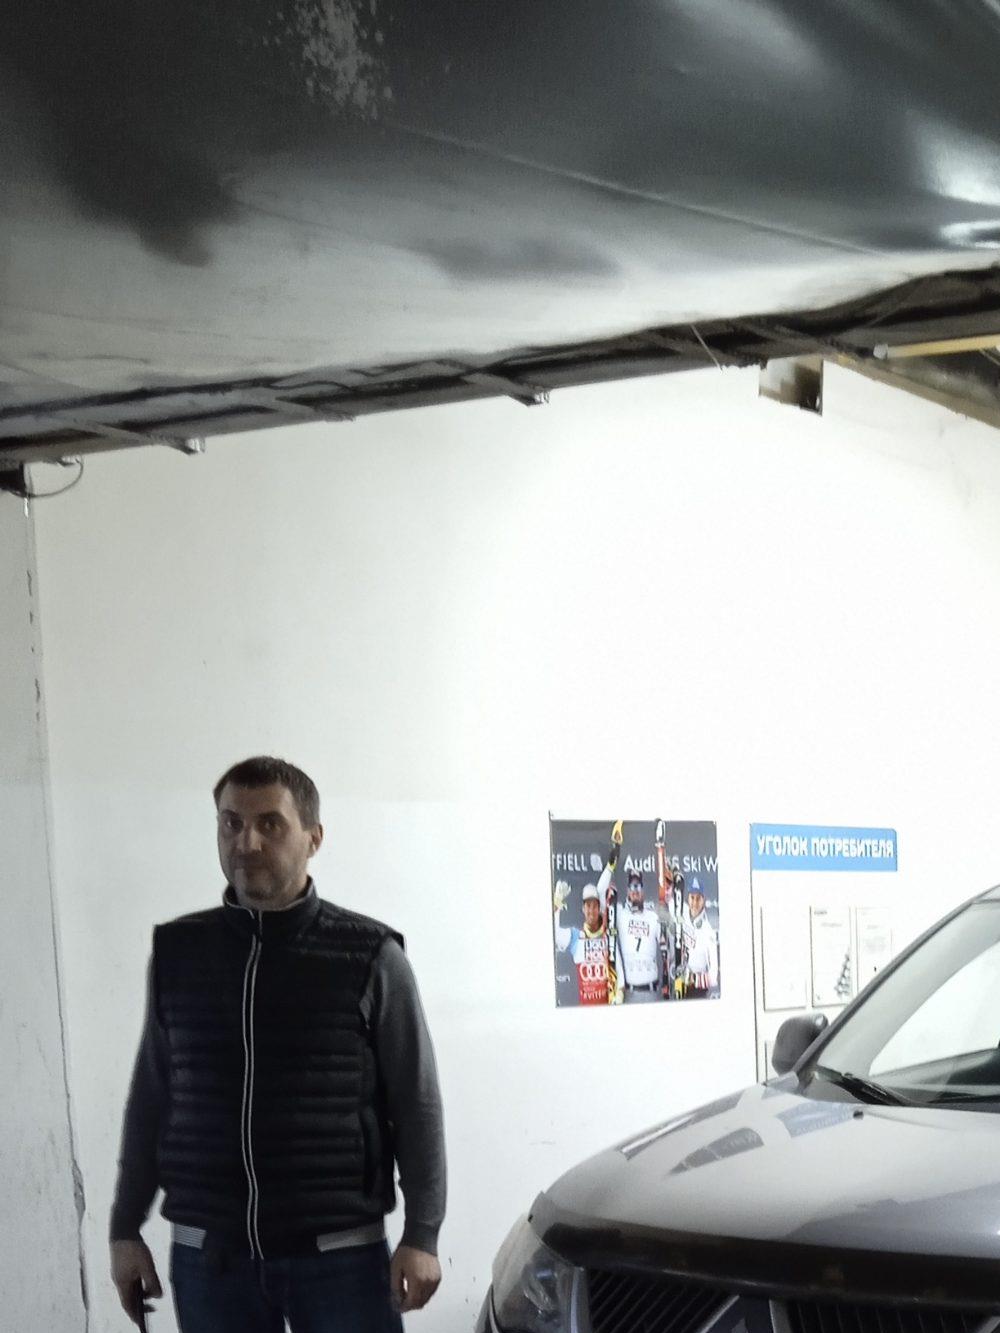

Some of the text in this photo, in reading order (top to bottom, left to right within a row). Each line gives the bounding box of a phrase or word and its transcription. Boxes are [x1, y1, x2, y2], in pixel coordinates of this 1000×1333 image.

[757, 834, 895, 859] УГОЛОК ПОТРЕБИТЕЛЯ
[623, 854, 656, 873] Audi
